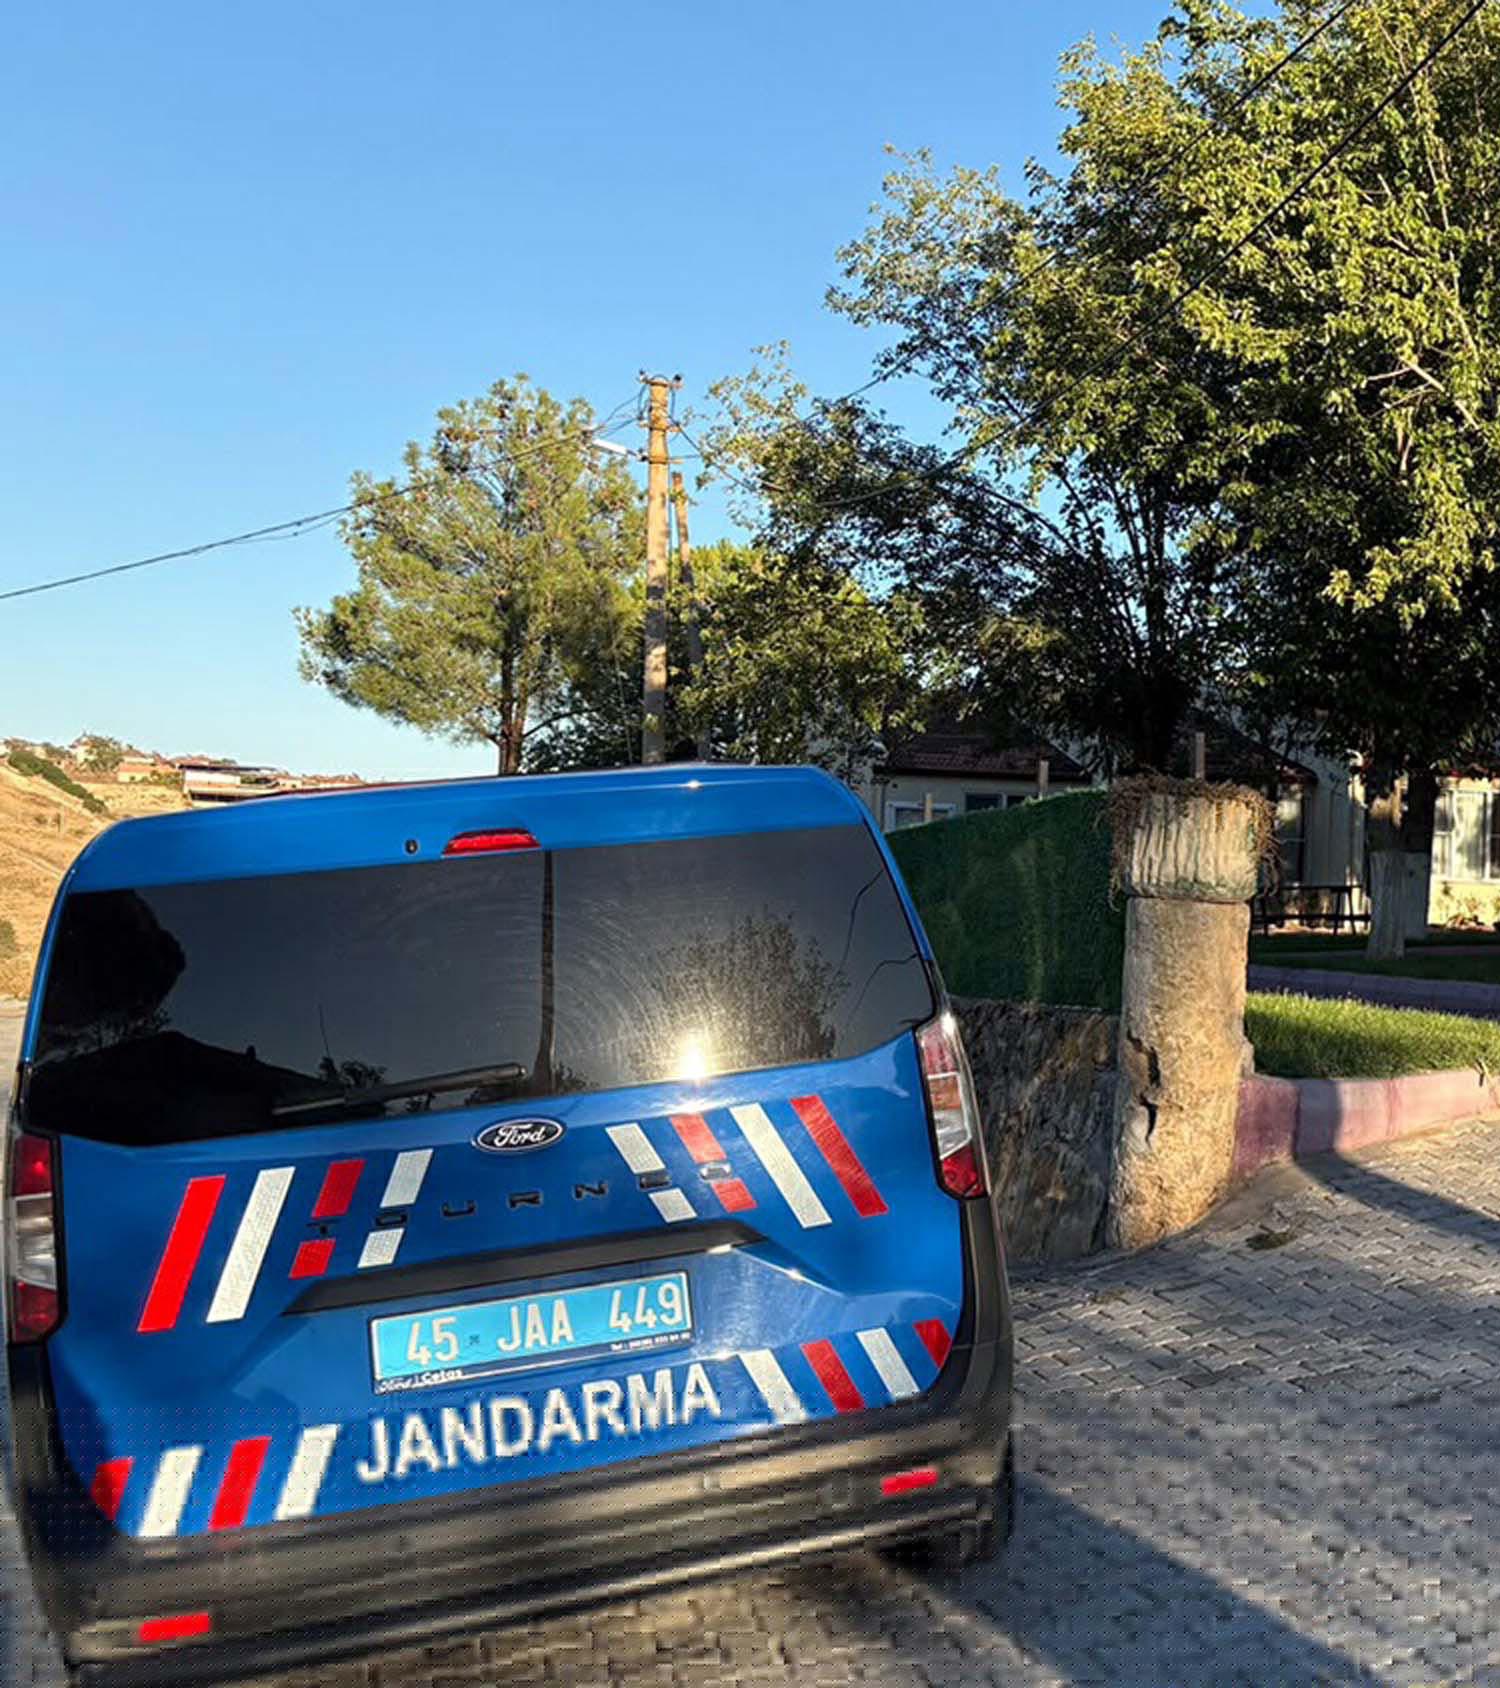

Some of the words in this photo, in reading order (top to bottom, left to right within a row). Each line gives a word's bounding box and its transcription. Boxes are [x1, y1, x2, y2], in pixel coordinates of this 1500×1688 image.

[495, 1123, 545, 1147] Ford
[406, 1315, 460, 1366] 45
[496, 1299, 576, 1352] JAA
[608, 1281, 684, 1333] 449
[357, 1362, 722, 1483] JANDARMA
